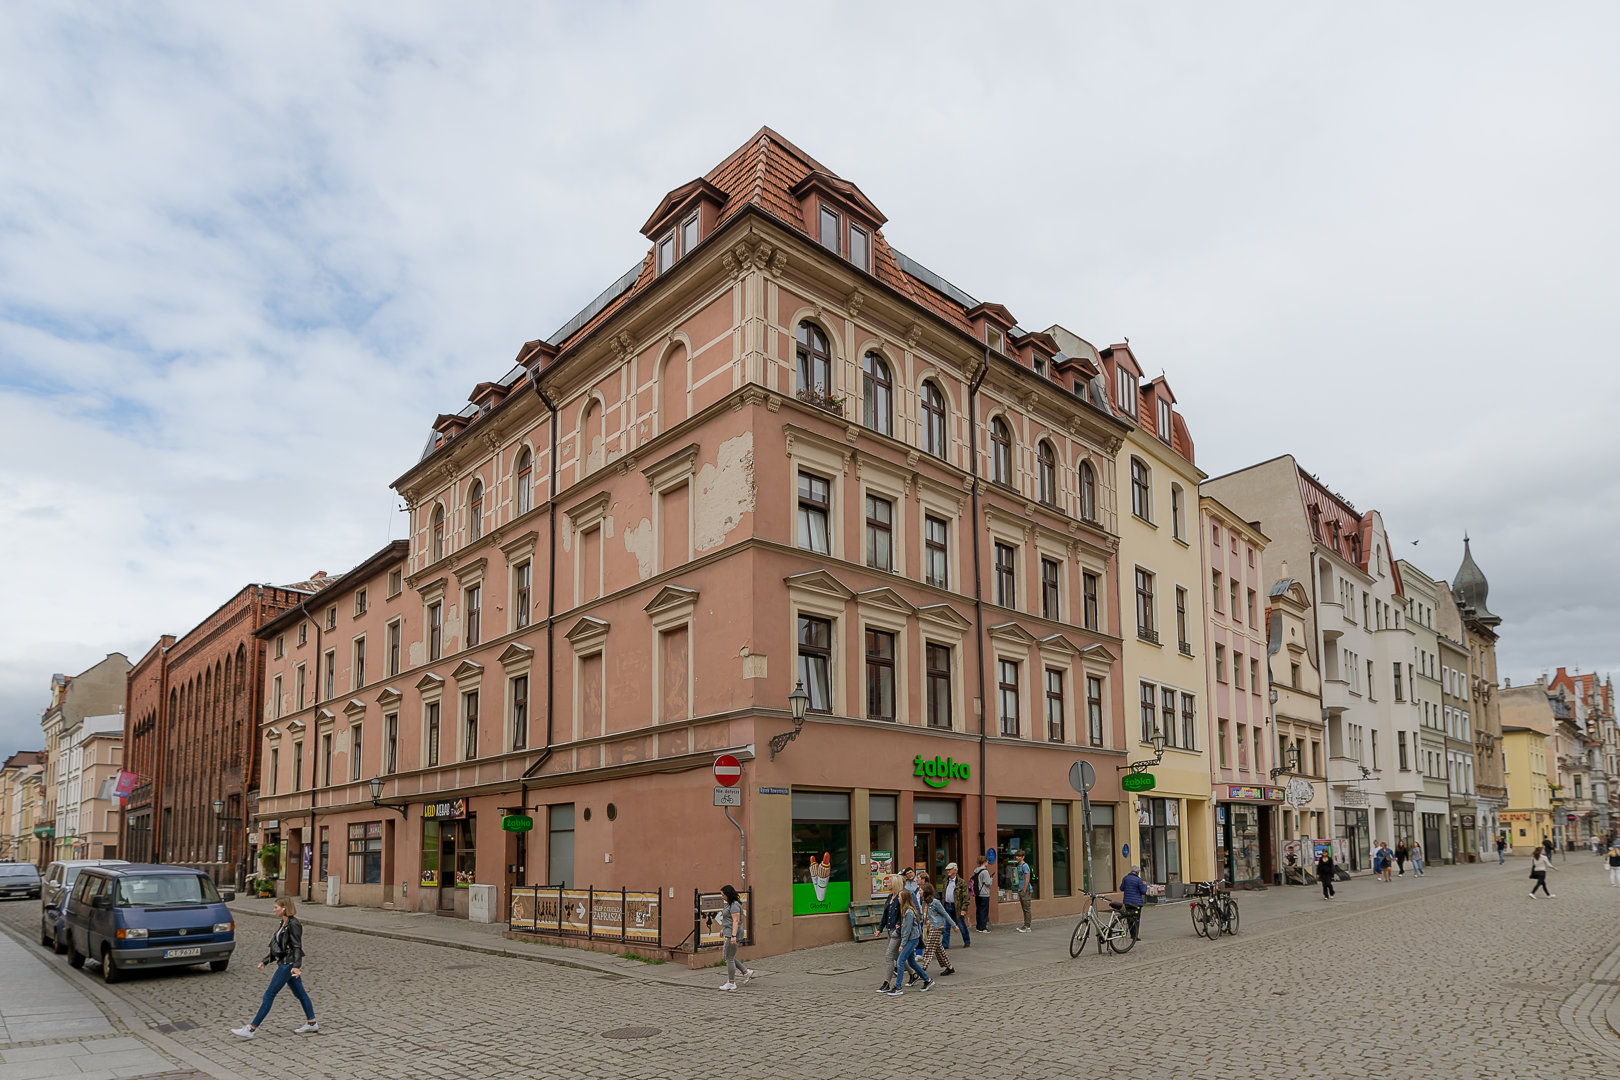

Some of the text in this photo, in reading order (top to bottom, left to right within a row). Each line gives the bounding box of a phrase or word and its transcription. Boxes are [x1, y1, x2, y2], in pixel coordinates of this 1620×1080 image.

[913, 754, 970, 779] żabka
[1124, 777, 1151, 786] żabka
[436, 803, 450, 816] KEBAB
[506, 819, 531, 827] żabka
